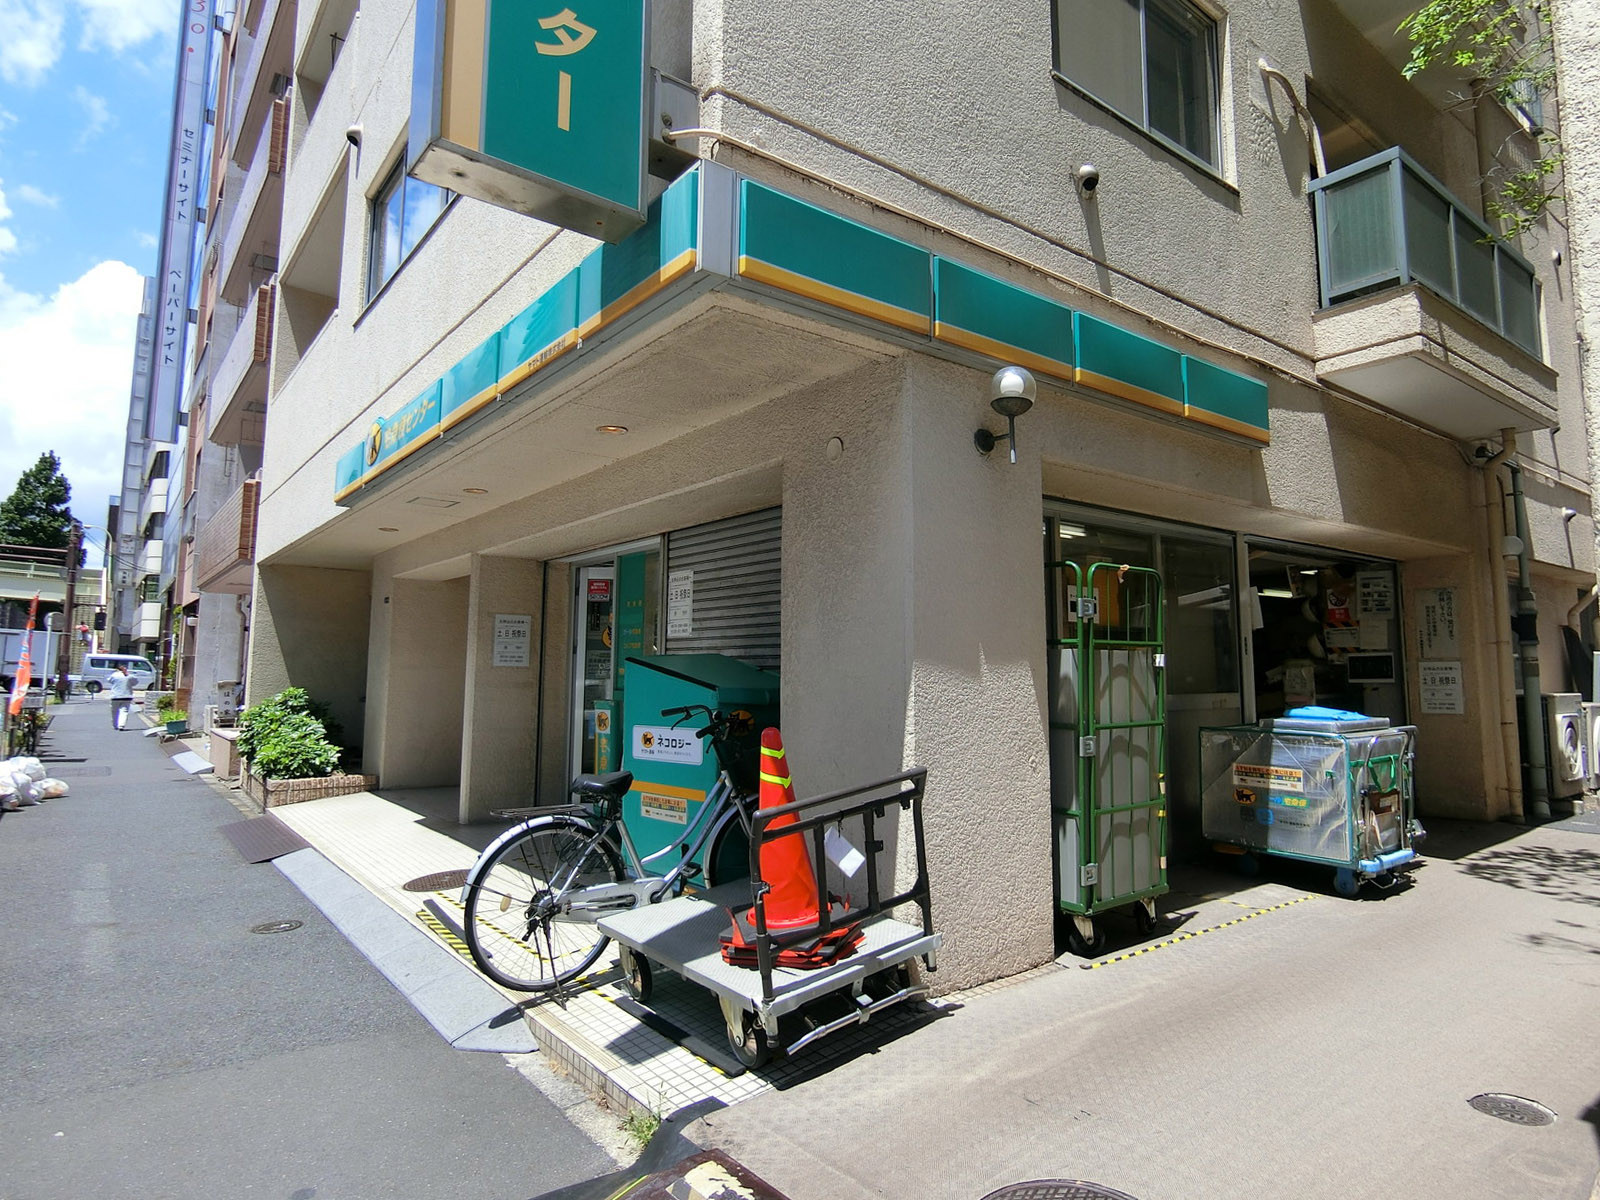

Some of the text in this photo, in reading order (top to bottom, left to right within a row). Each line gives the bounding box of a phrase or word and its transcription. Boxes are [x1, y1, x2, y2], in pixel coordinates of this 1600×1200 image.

[535, 8, 597, 132] ター
[177, 128, 194, 220] セミナーサイト
[163, 270, 182, 365] ペーパーサイト
[657, 733, 692, 749] ネコロジー
